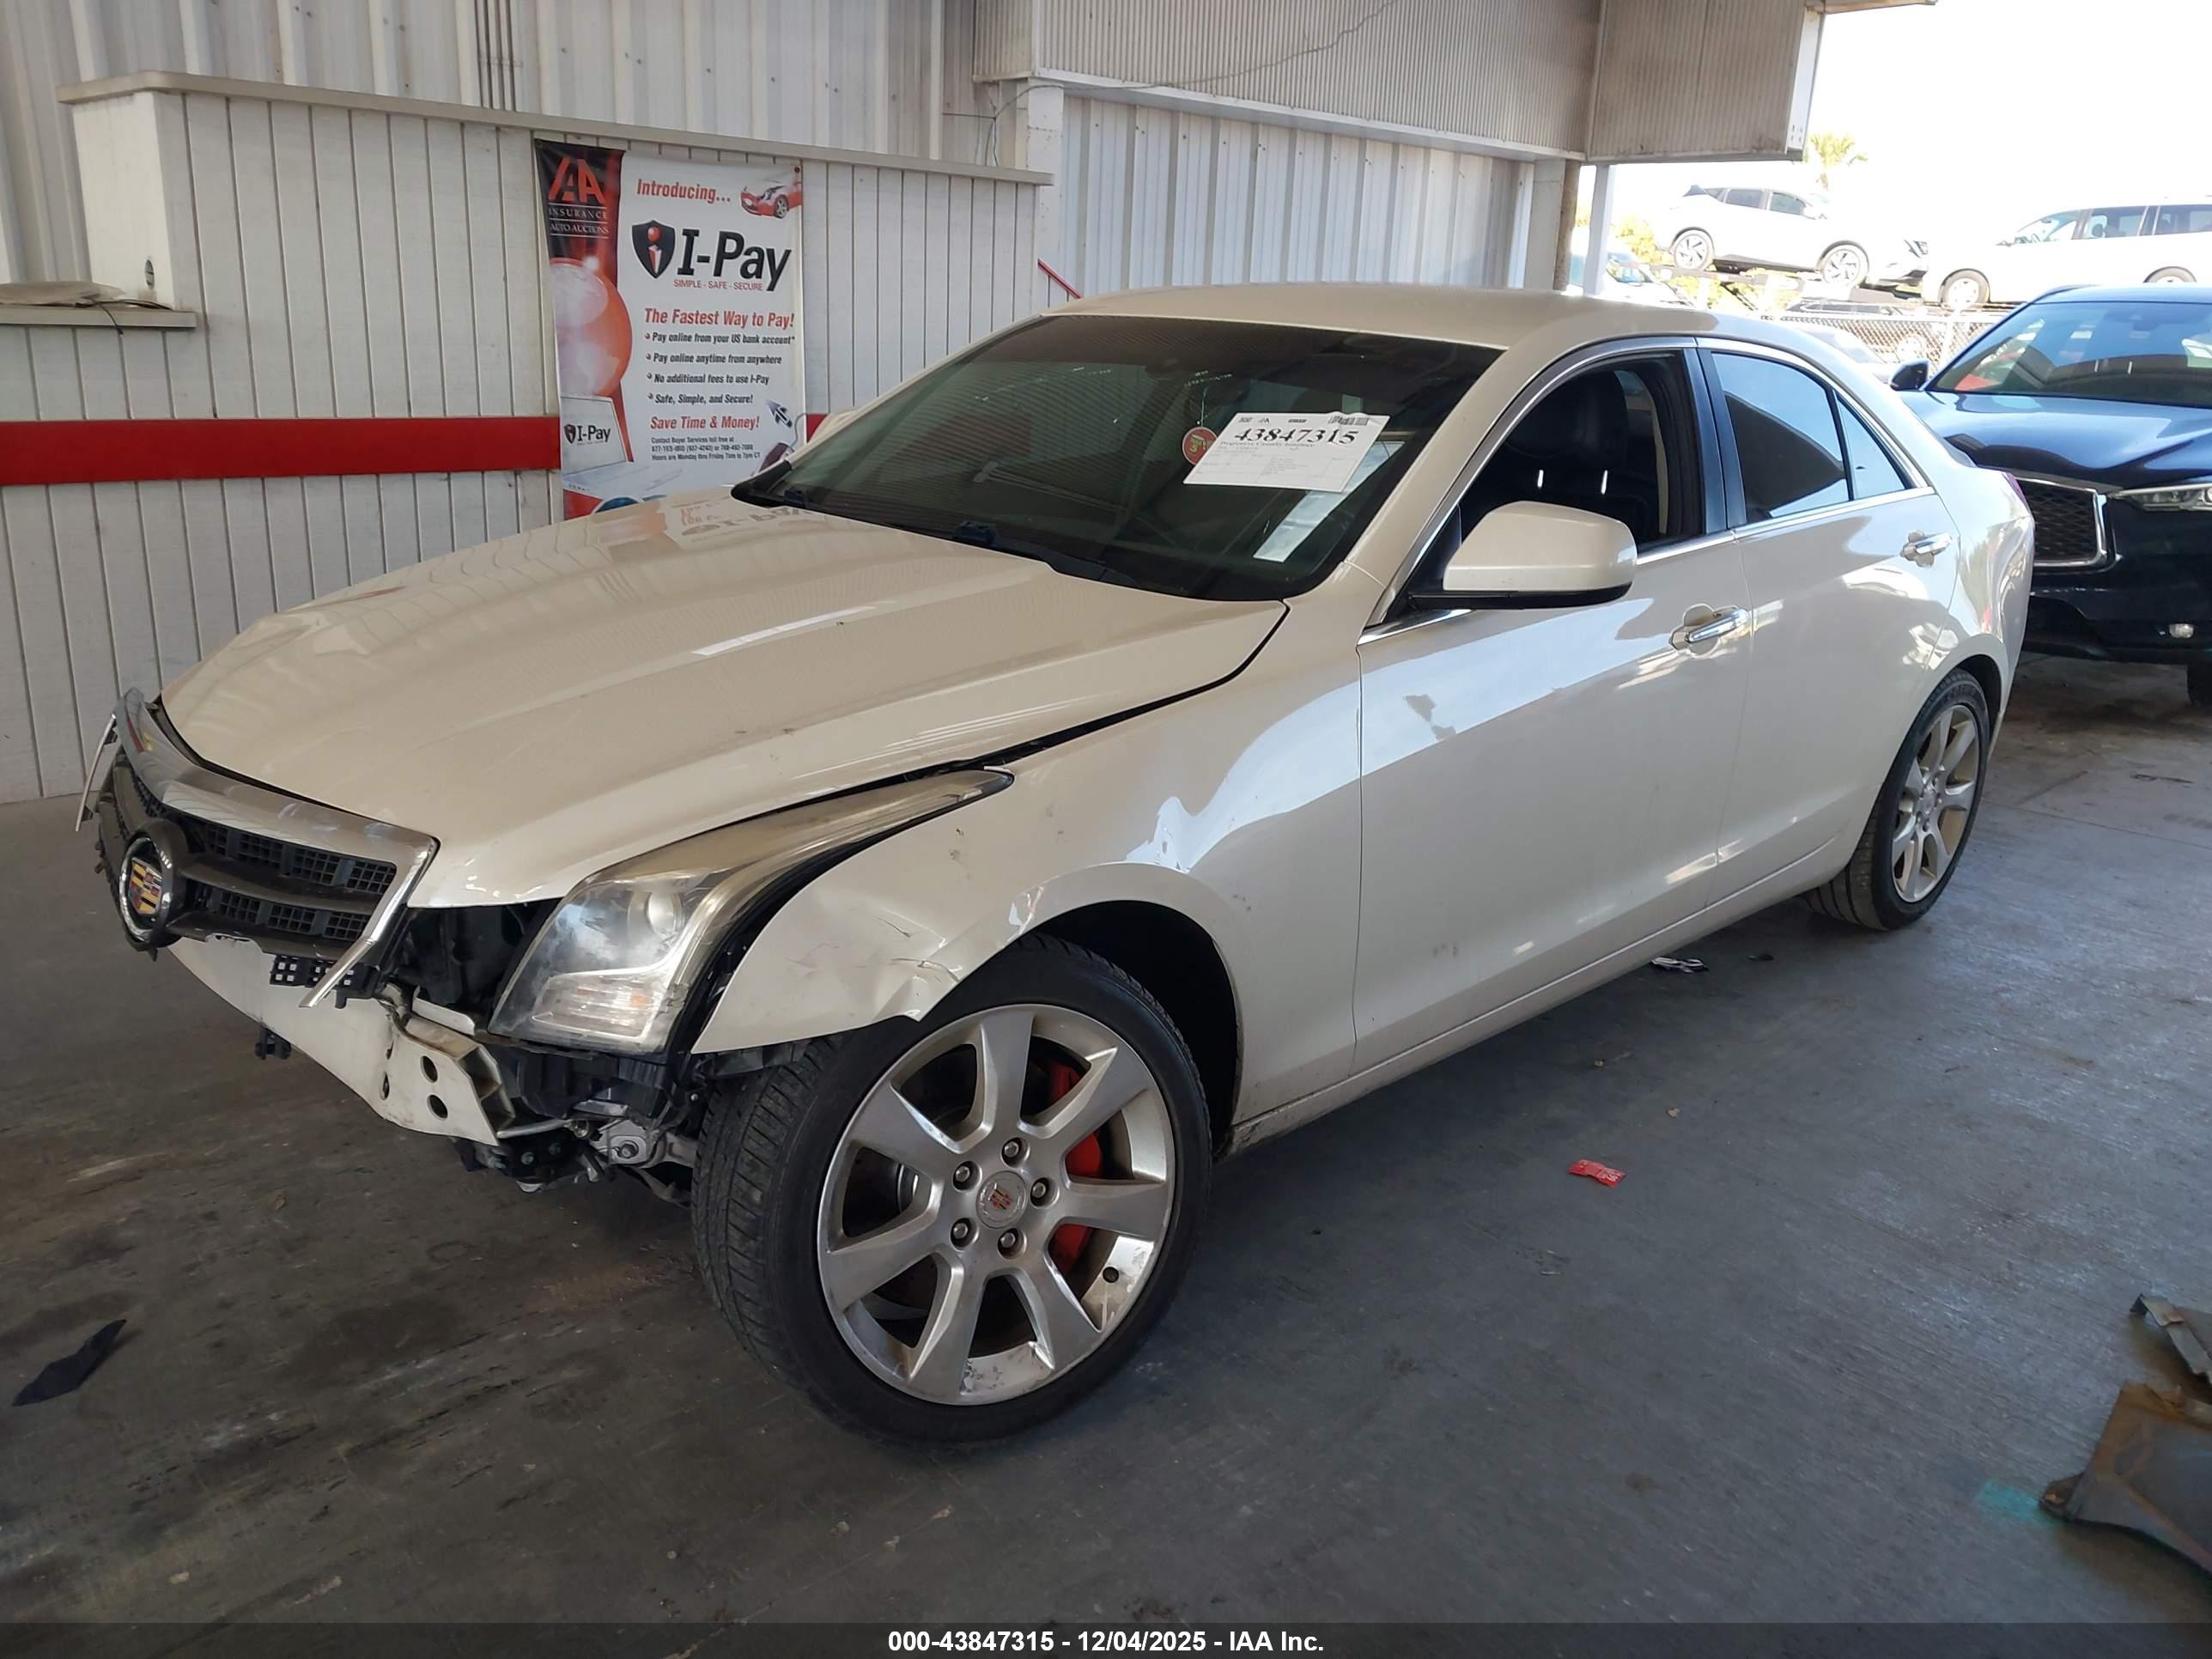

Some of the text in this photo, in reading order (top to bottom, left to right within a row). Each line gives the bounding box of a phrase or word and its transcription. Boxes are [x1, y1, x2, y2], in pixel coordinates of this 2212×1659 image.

[636, 178, 731, 204] Introducing...
[548, 208, 609, 221] INSURANCE
[677, 228, 792, 292] I-Pay
[673, 278, 701, 289] SIMPLE
[707, 280, 727, 289] SAFE
[733, 281, 763, 291] SECURE
[645, 308, 795, 330] The Fastest Way to Pay!
[652, 332, 667, 343] Pay
[668, 333, 692, 342] online
[694, 333, 712, 342] from
[713, 335, 729, 344] your
[731, 334, 741, 343] US
[742, 334, 760, 343] bank
[653, 353, 782, 365] Pay online anytime from anywhere
[654, 374, 665, 383] No
[666, 374, 706, 383] additional
[708, 374, 724, 383] fees
[726, 375, 733, 383] to
[750, 374, 770, 385] I-Pay
[655, 394, 754, 405] Safe, Simple, and Secure!
[650, 416, 760, 431] Save Time & Money!
[577, 425, 611, 443] I-Pay
[1234, 428, 1360, 445] 43847315
